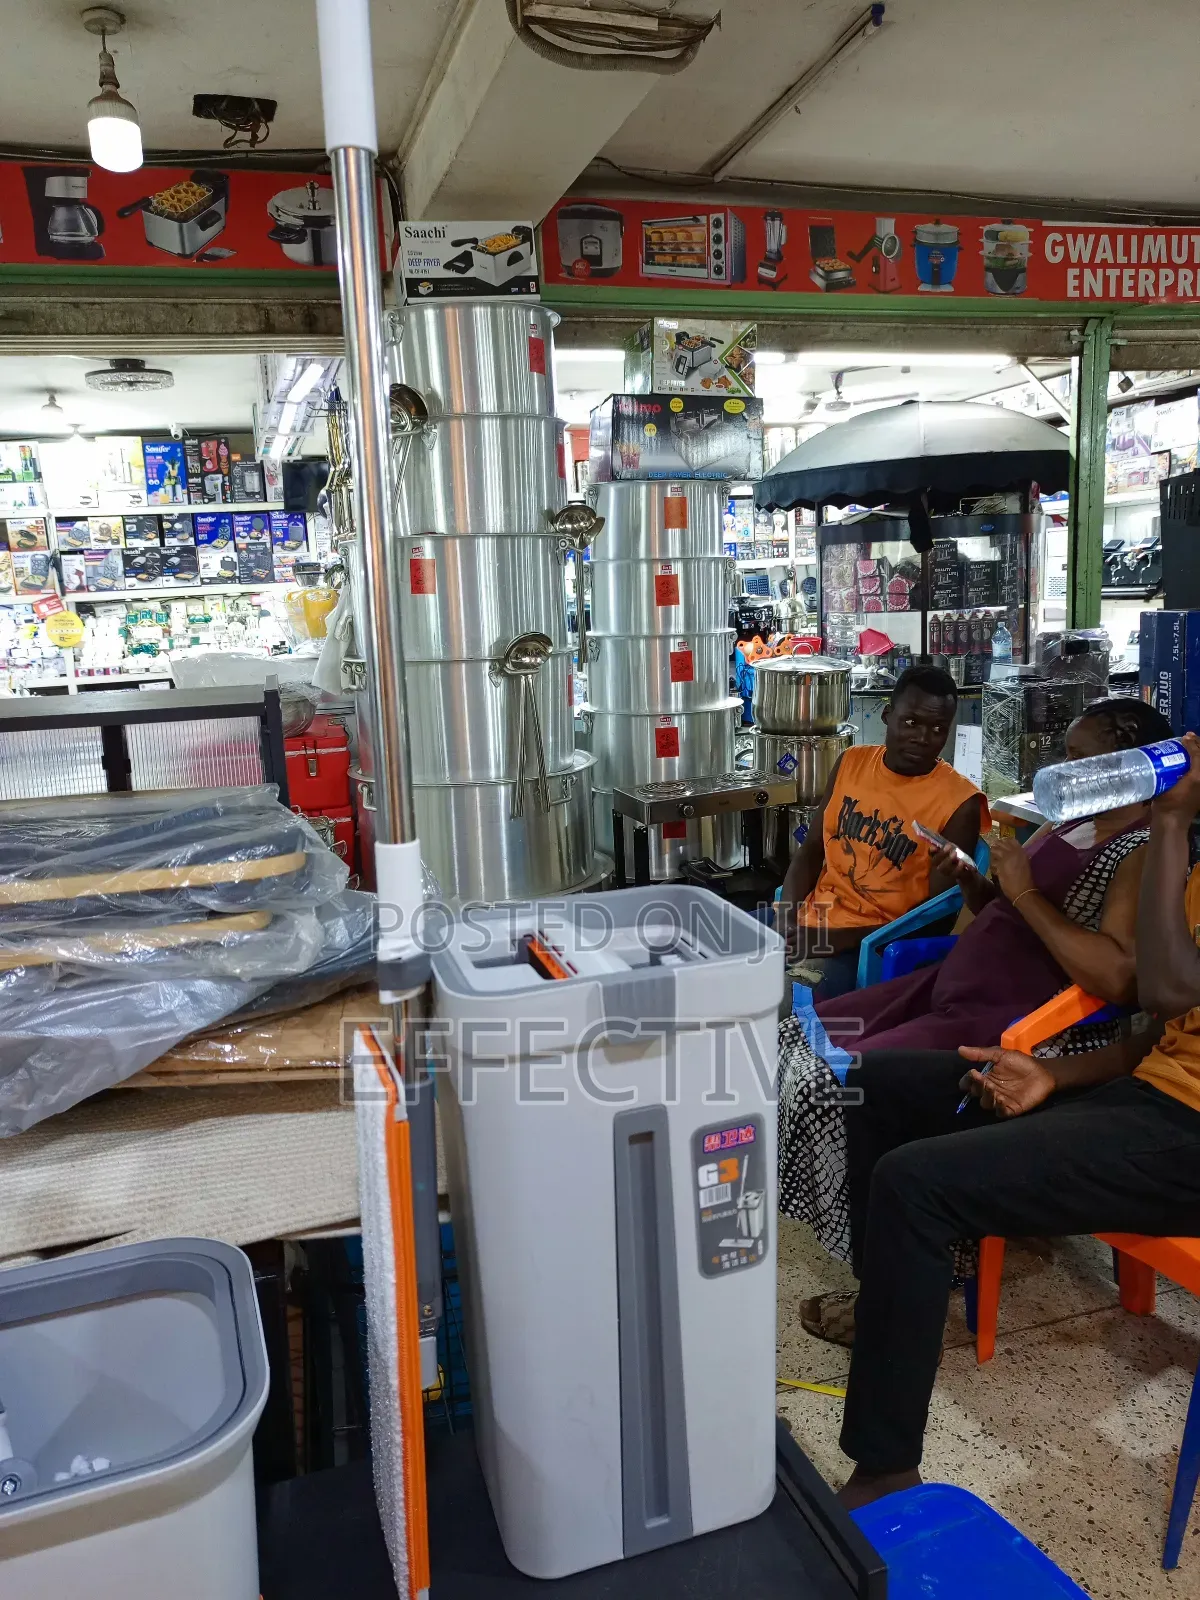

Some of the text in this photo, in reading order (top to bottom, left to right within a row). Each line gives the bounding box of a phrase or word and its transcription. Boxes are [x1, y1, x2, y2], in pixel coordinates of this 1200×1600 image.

[404, 226, 446, 239] Saachi
[1044, 232, 1200, 264] GWALIMUT
[423, 258, 441, 267] FRYER
[145, 444, 171, 454] Sonifer
[1159, 671, 1169, 696] JUG
[698, 1157, 740, 1189] G3
